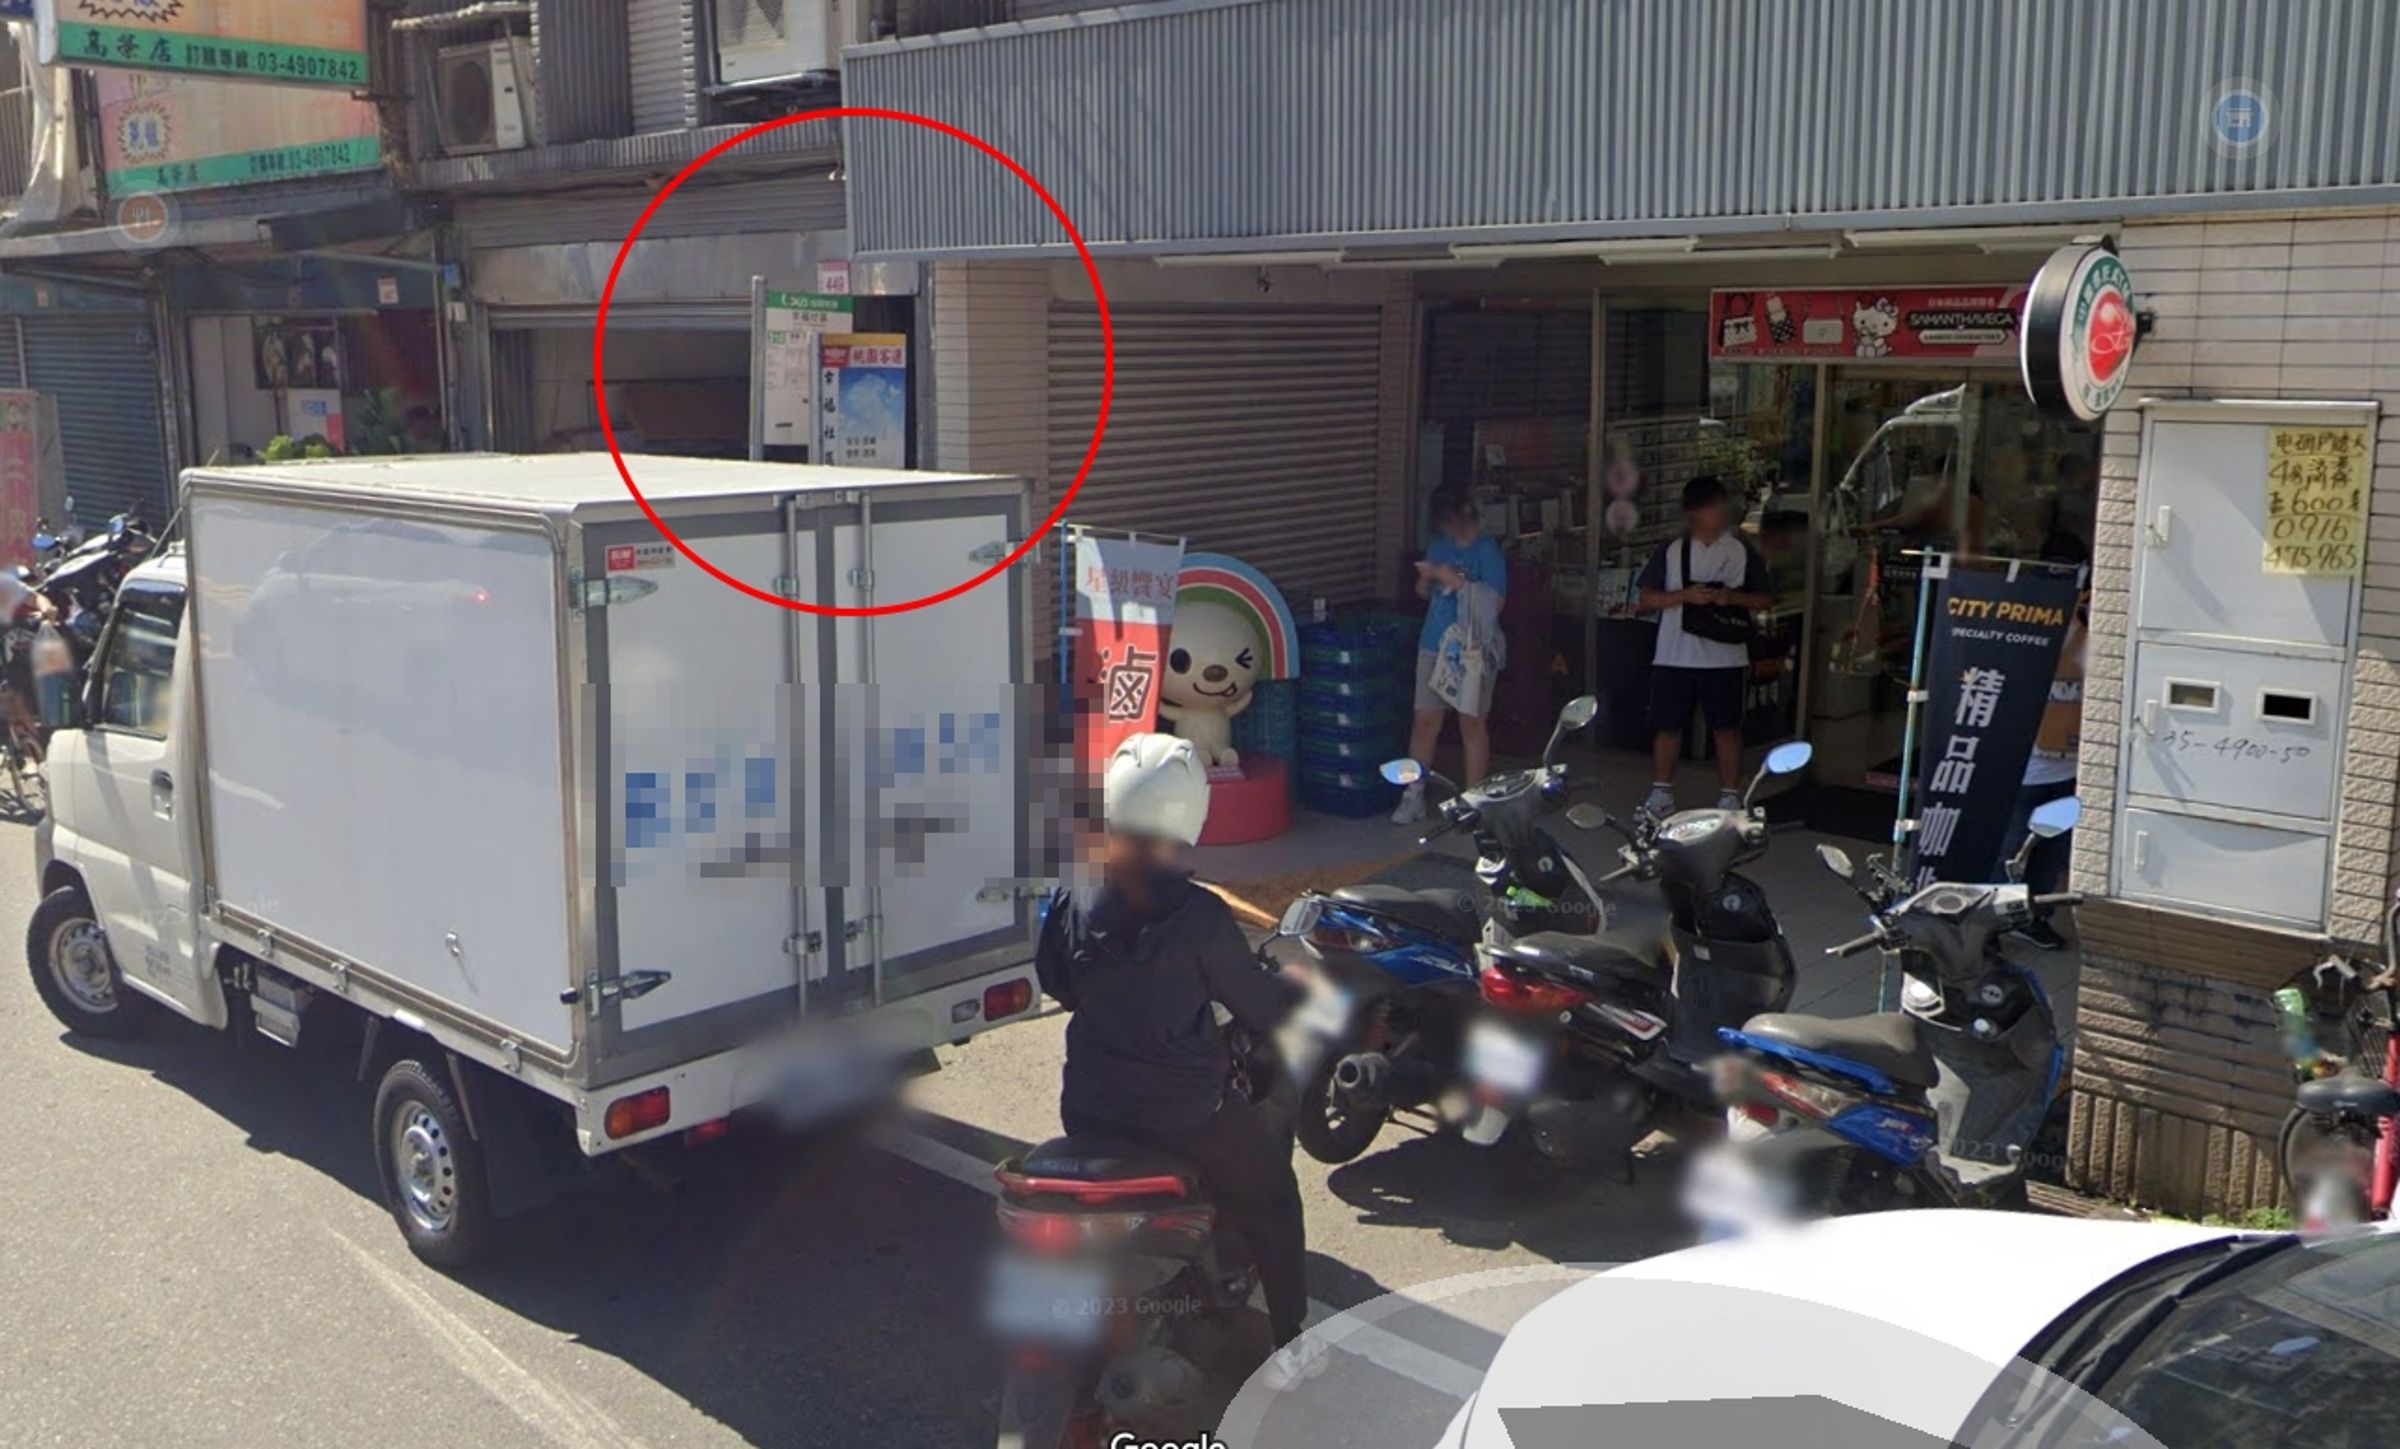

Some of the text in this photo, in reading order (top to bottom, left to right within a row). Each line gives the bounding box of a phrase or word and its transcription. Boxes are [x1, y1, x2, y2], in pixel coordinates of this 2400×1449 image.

[257, 52, 358, 80] 03-4907842
[2273, 513, 2348, 541] 0916
[1947, 597, 2064, 627] CITY PRIMA
[2006, 632, 2049, 647] COFFEE
